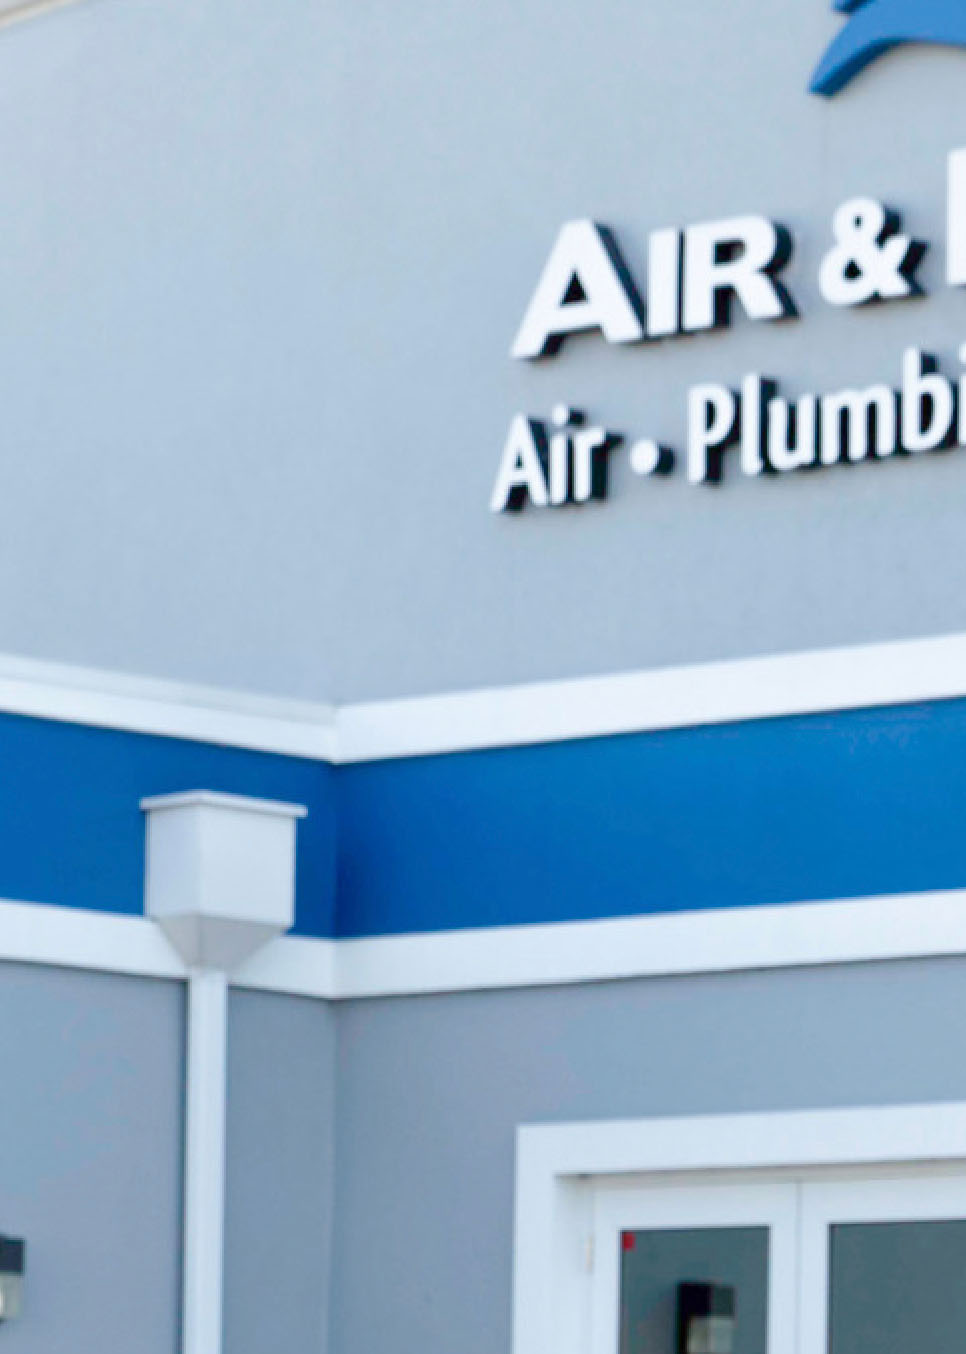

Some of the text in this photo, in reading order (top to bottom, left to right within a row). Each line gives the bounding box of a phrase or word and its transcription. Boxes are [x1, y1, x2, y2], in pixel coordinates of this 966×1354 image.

[510, 214, 784, 359] AIR
[816, 195, 912, 307] &
[489, 402, 607, 513] Air
